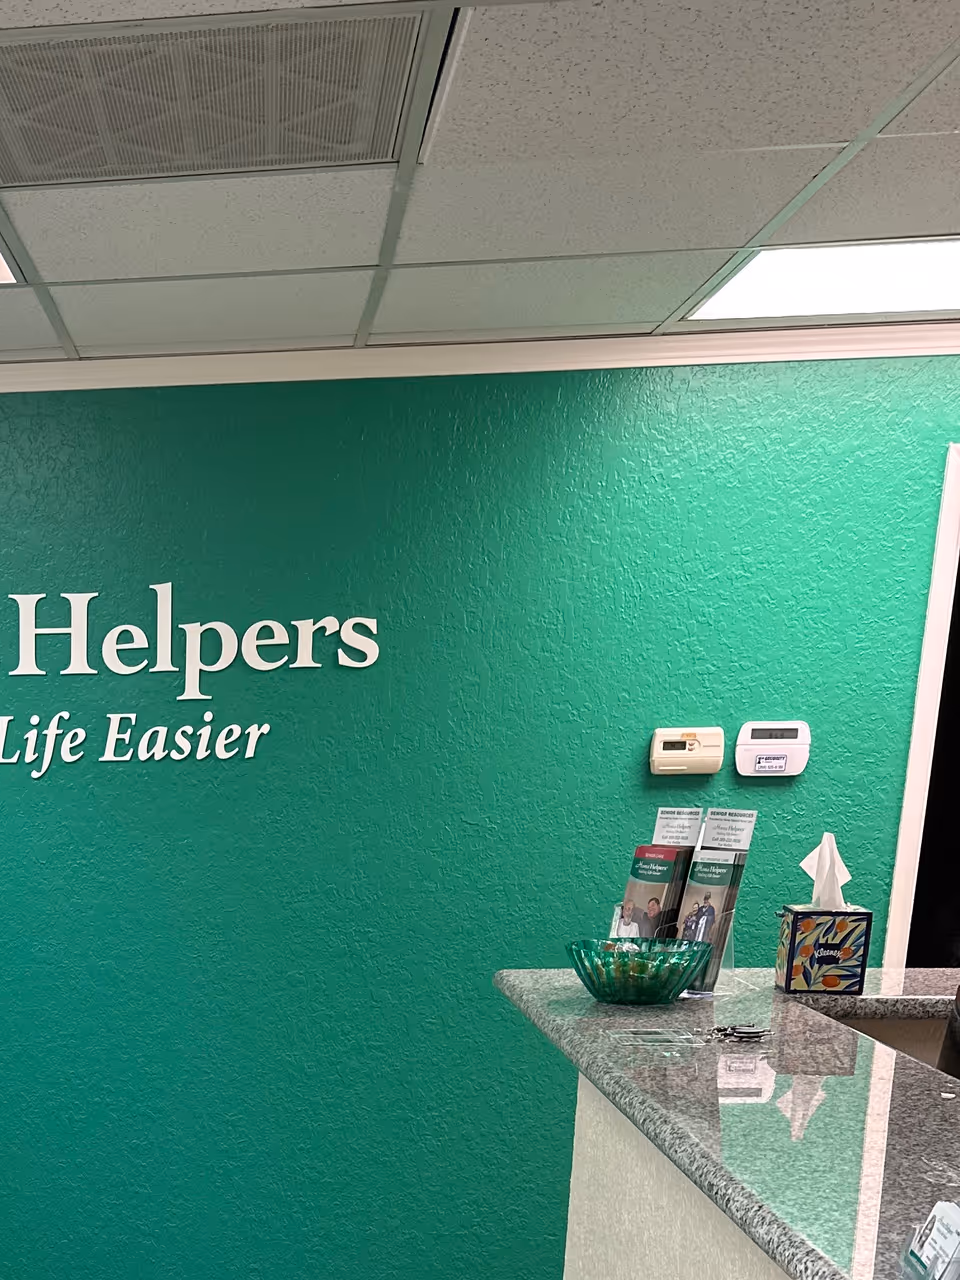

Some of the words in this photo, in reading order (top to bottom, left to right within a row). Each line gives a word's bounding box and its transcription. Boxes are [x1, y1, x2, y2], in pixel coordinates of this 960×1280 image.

[8, 582, 380, 700] Helpers
[99, 711, 271, 762] Easier
[814, 949, 843, 959] Kleenex
